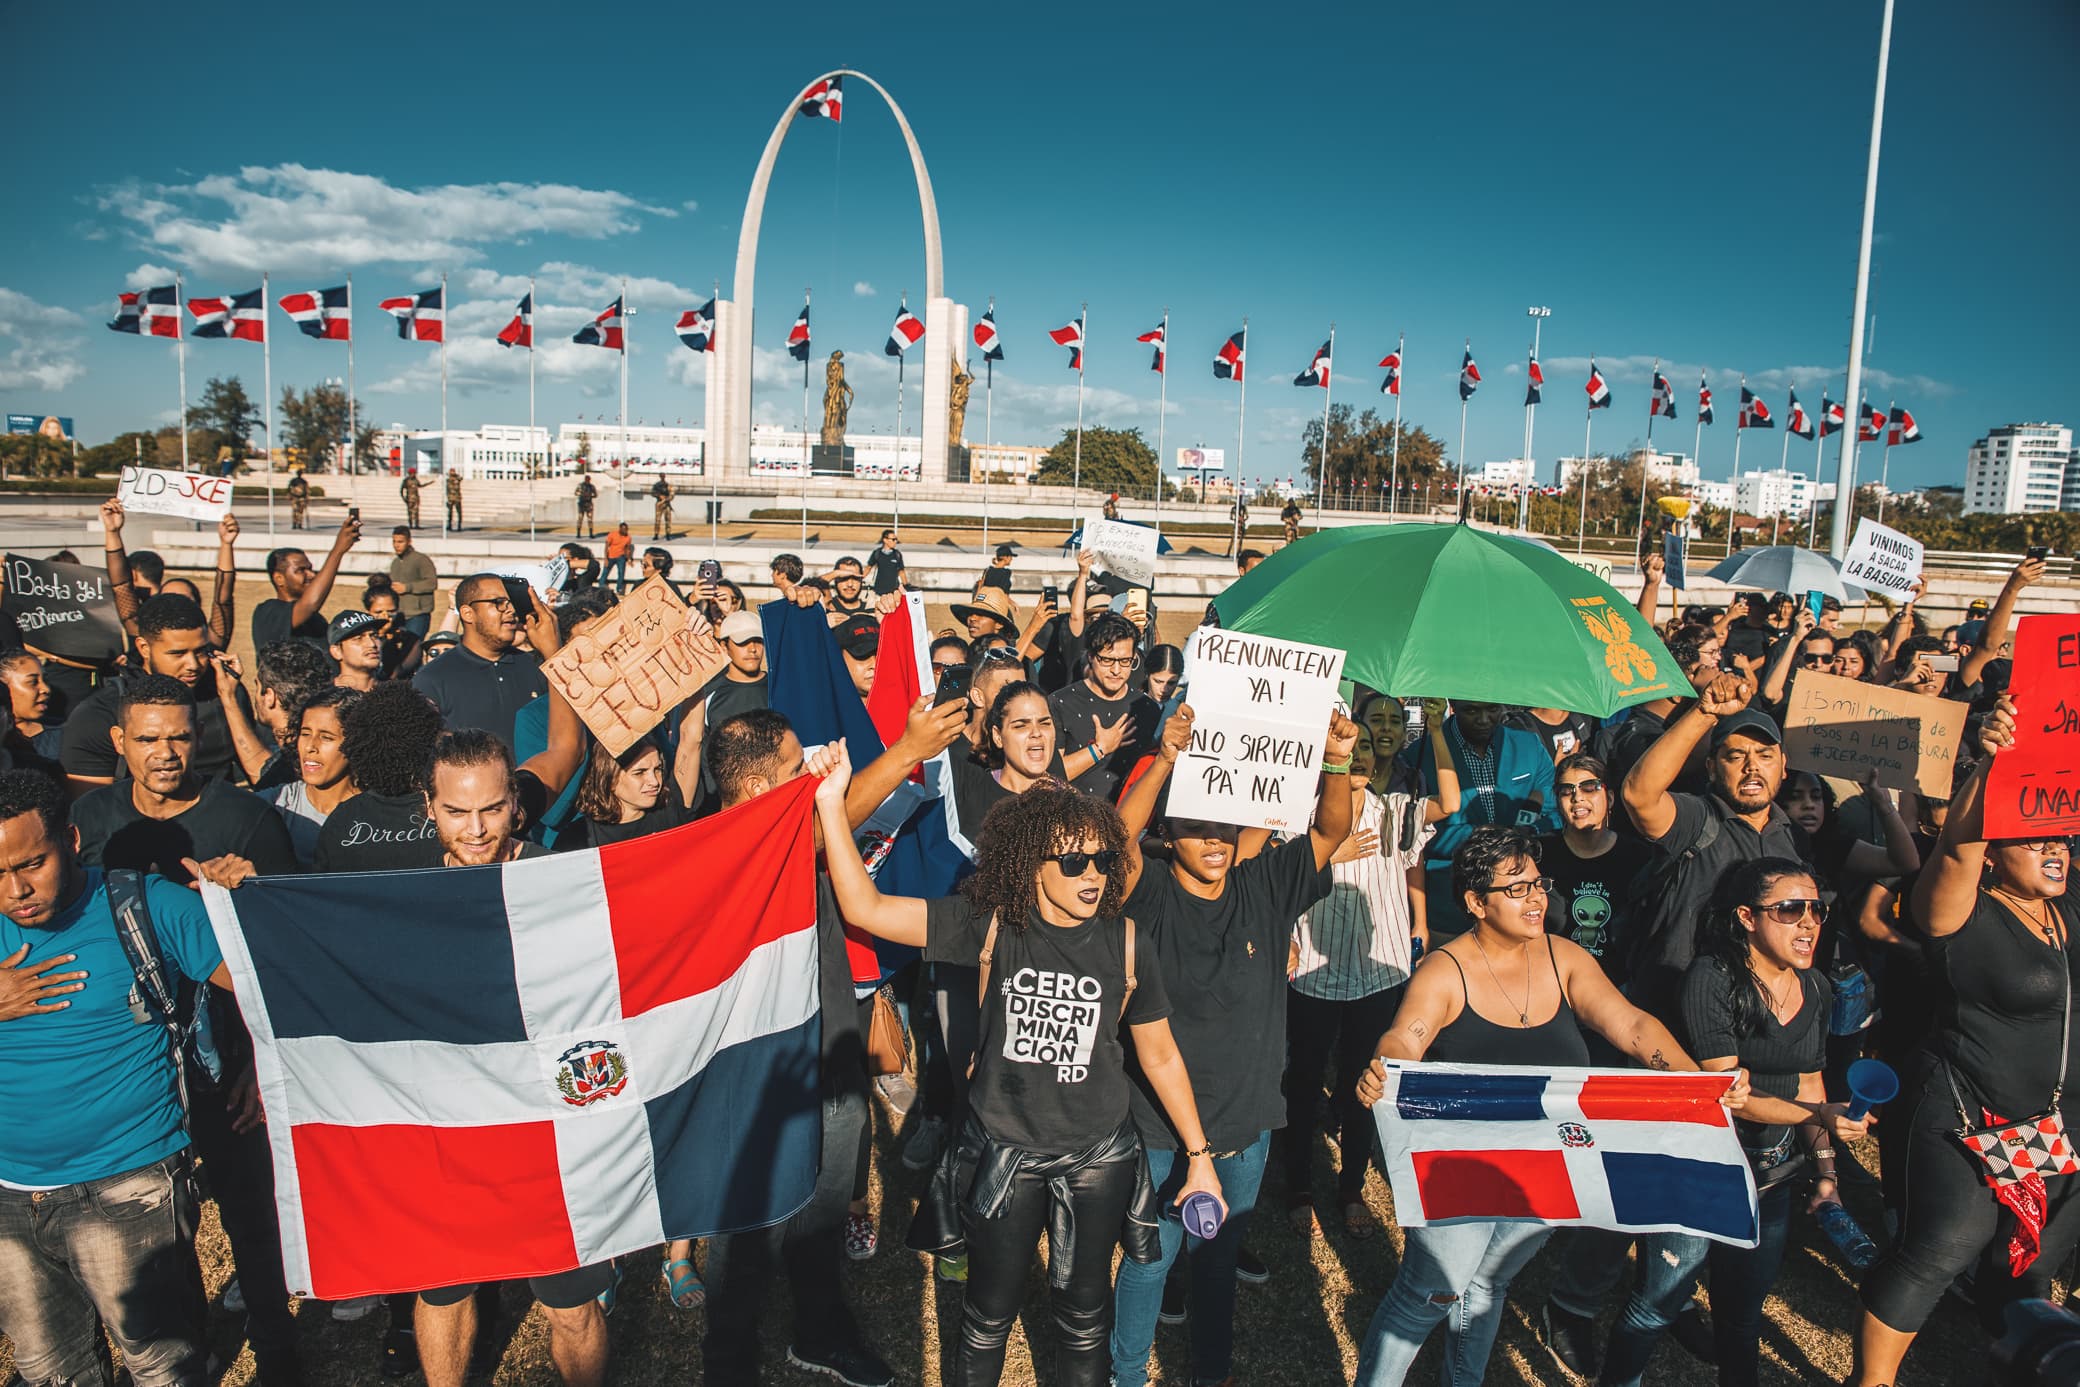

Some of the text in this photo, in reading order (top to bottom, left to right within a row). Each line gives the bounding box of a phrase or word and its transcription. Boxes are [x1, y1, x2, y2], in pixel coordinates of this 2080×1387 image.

[118, 465, 231, 504] PLD=JCE
[1869, 531, 1914, 561] VINIMOS
[1846, 560, 1912, 593] LA BASURA
[1868, 551, 1908, 574] A SACAR
[4, 560, 103, 602] ¡Basta ya!
[1197, 631, 1337, 679] ¡RENUNCIEN
[2058, 633, 2080, 669] E
[1929, 720, 1947, 737] de
[2043, 699, 2080, 734] JA
[1189, 728, 1314, 769] NO SIRVEN
[1849, 731, 1860, 745] A
[1871, 733, 1889, 751] LA
[1897, 738, 1950, 762] BASURA
[340, 814, 438, 847] Directo
[1573, 887, 1610, 898] believe in
[1001, 967, 1103, 1002] #CERO
[1009, 995, 1095, 1027] DISCRI
[1016, 1017, 1079, 1045] MINA
[1013, 1037, 1077, 1063] CIÓN
[1056, 1065, 1089, 1084] RD
